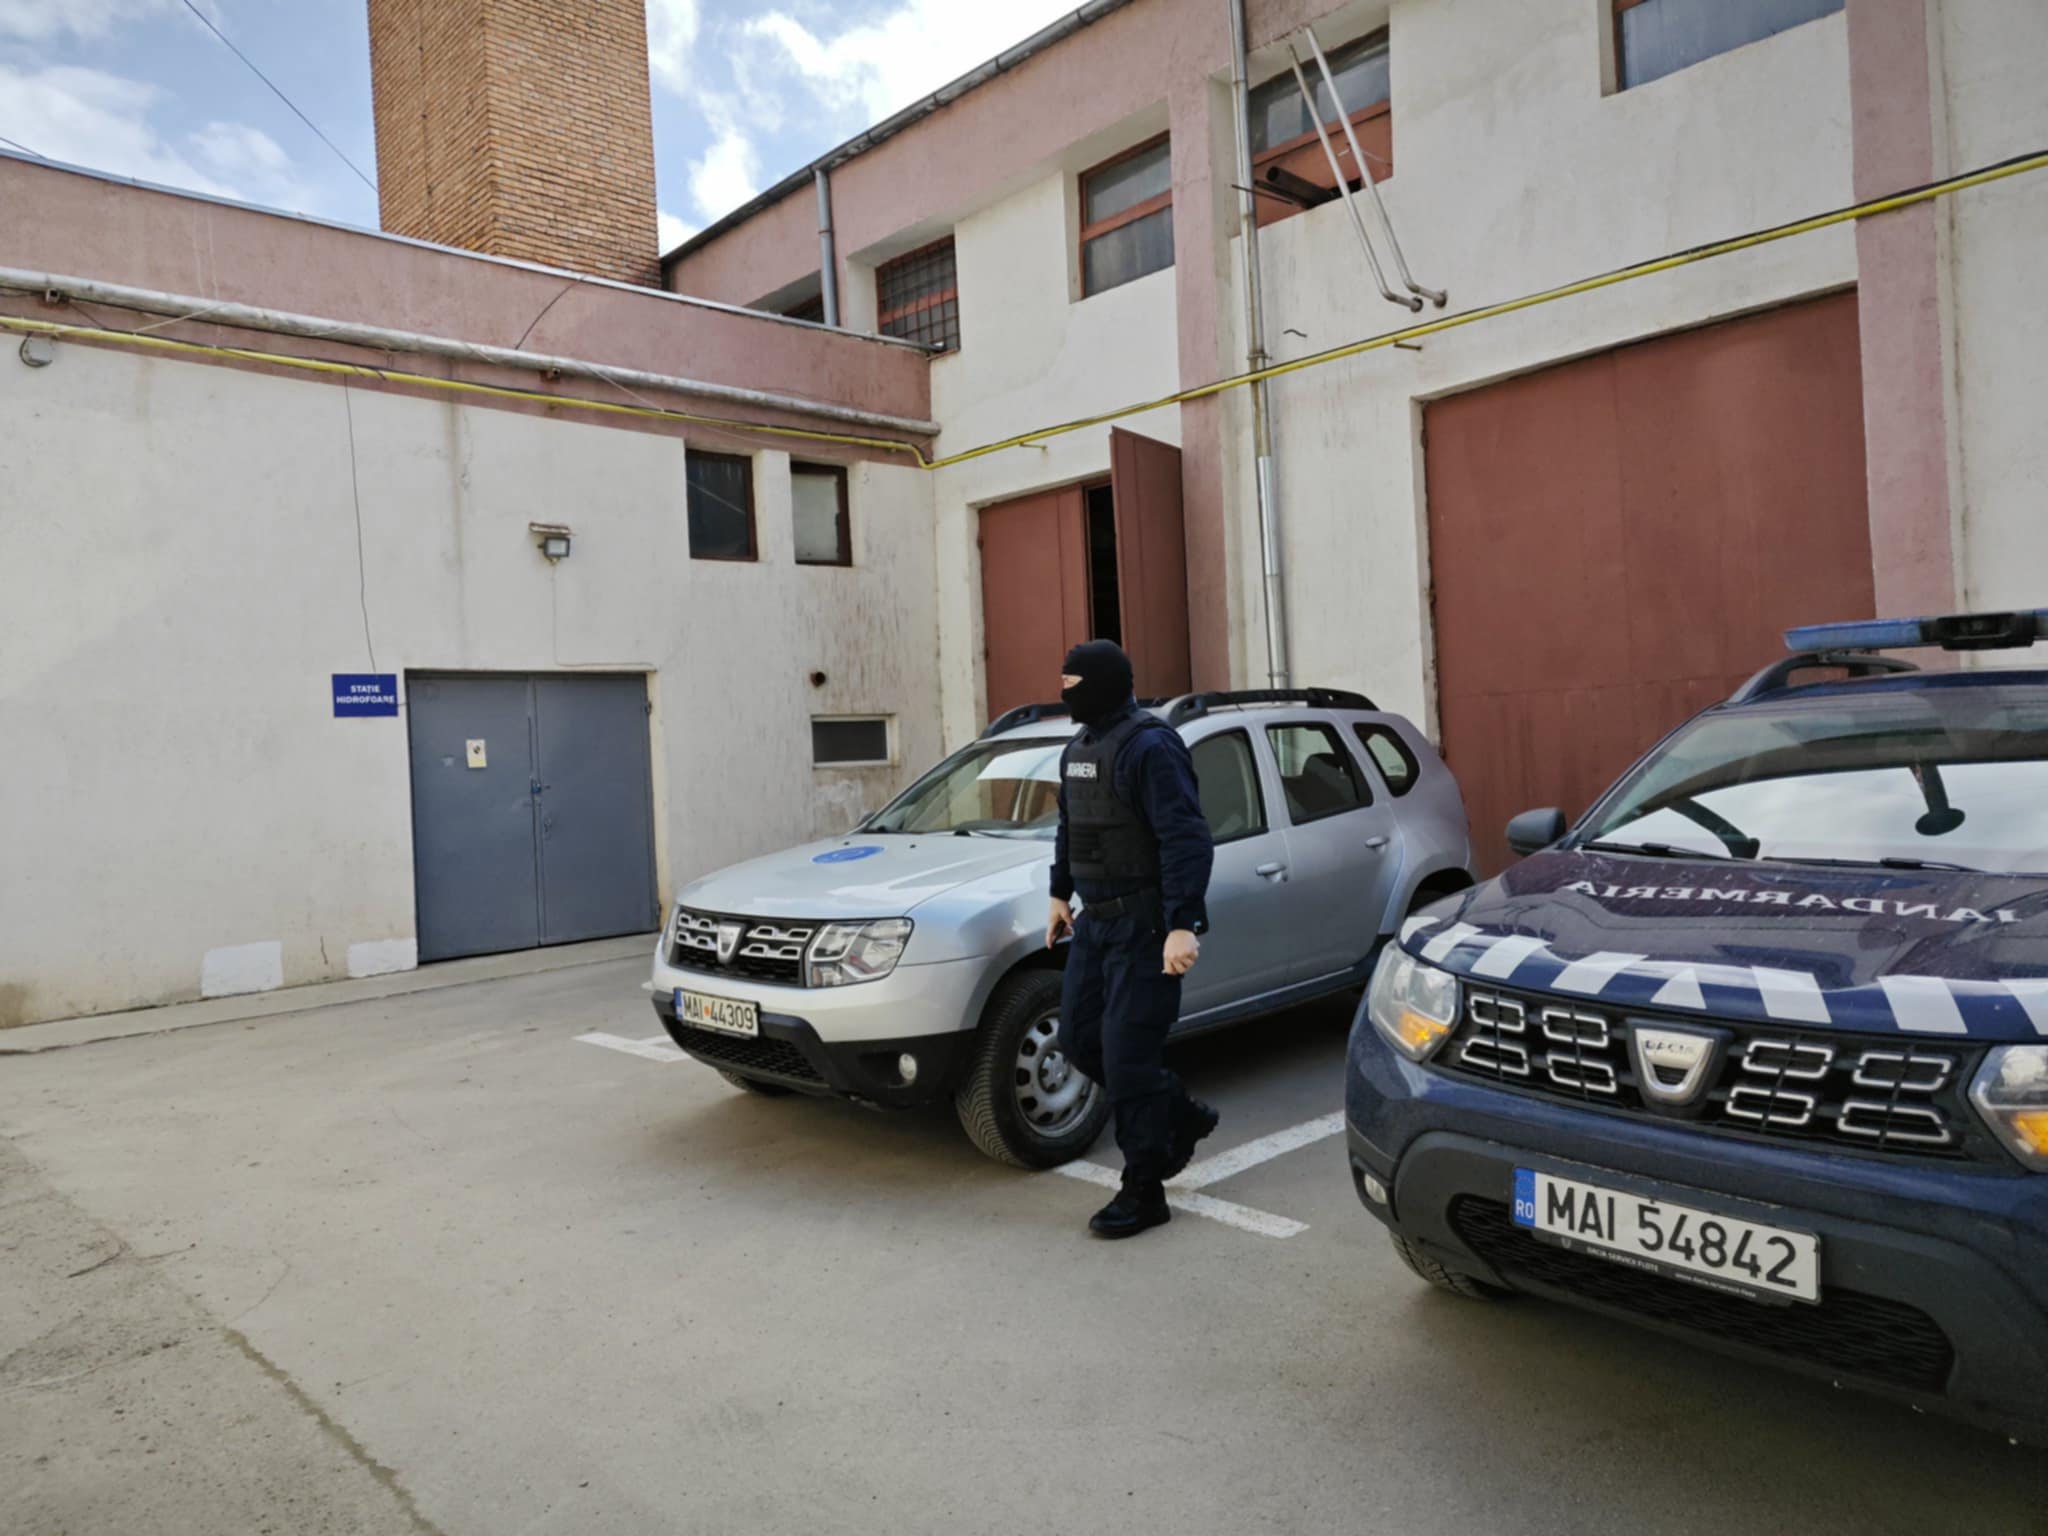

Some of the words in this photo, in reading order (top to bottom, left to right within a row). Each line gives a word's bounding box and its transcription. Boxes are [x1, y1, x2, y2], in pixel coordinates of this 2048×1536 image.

[336, 695, 395, 704] HIDROFOARE
[683, 993, 703, 1020] MAI
[711, 1001, 754, 1030] 44309
[1515, 1199, 1534, 1219] RO
[1547, 1182, 1615, 1241] MAI
[1637, 1204, 1797, 1288] 54842
